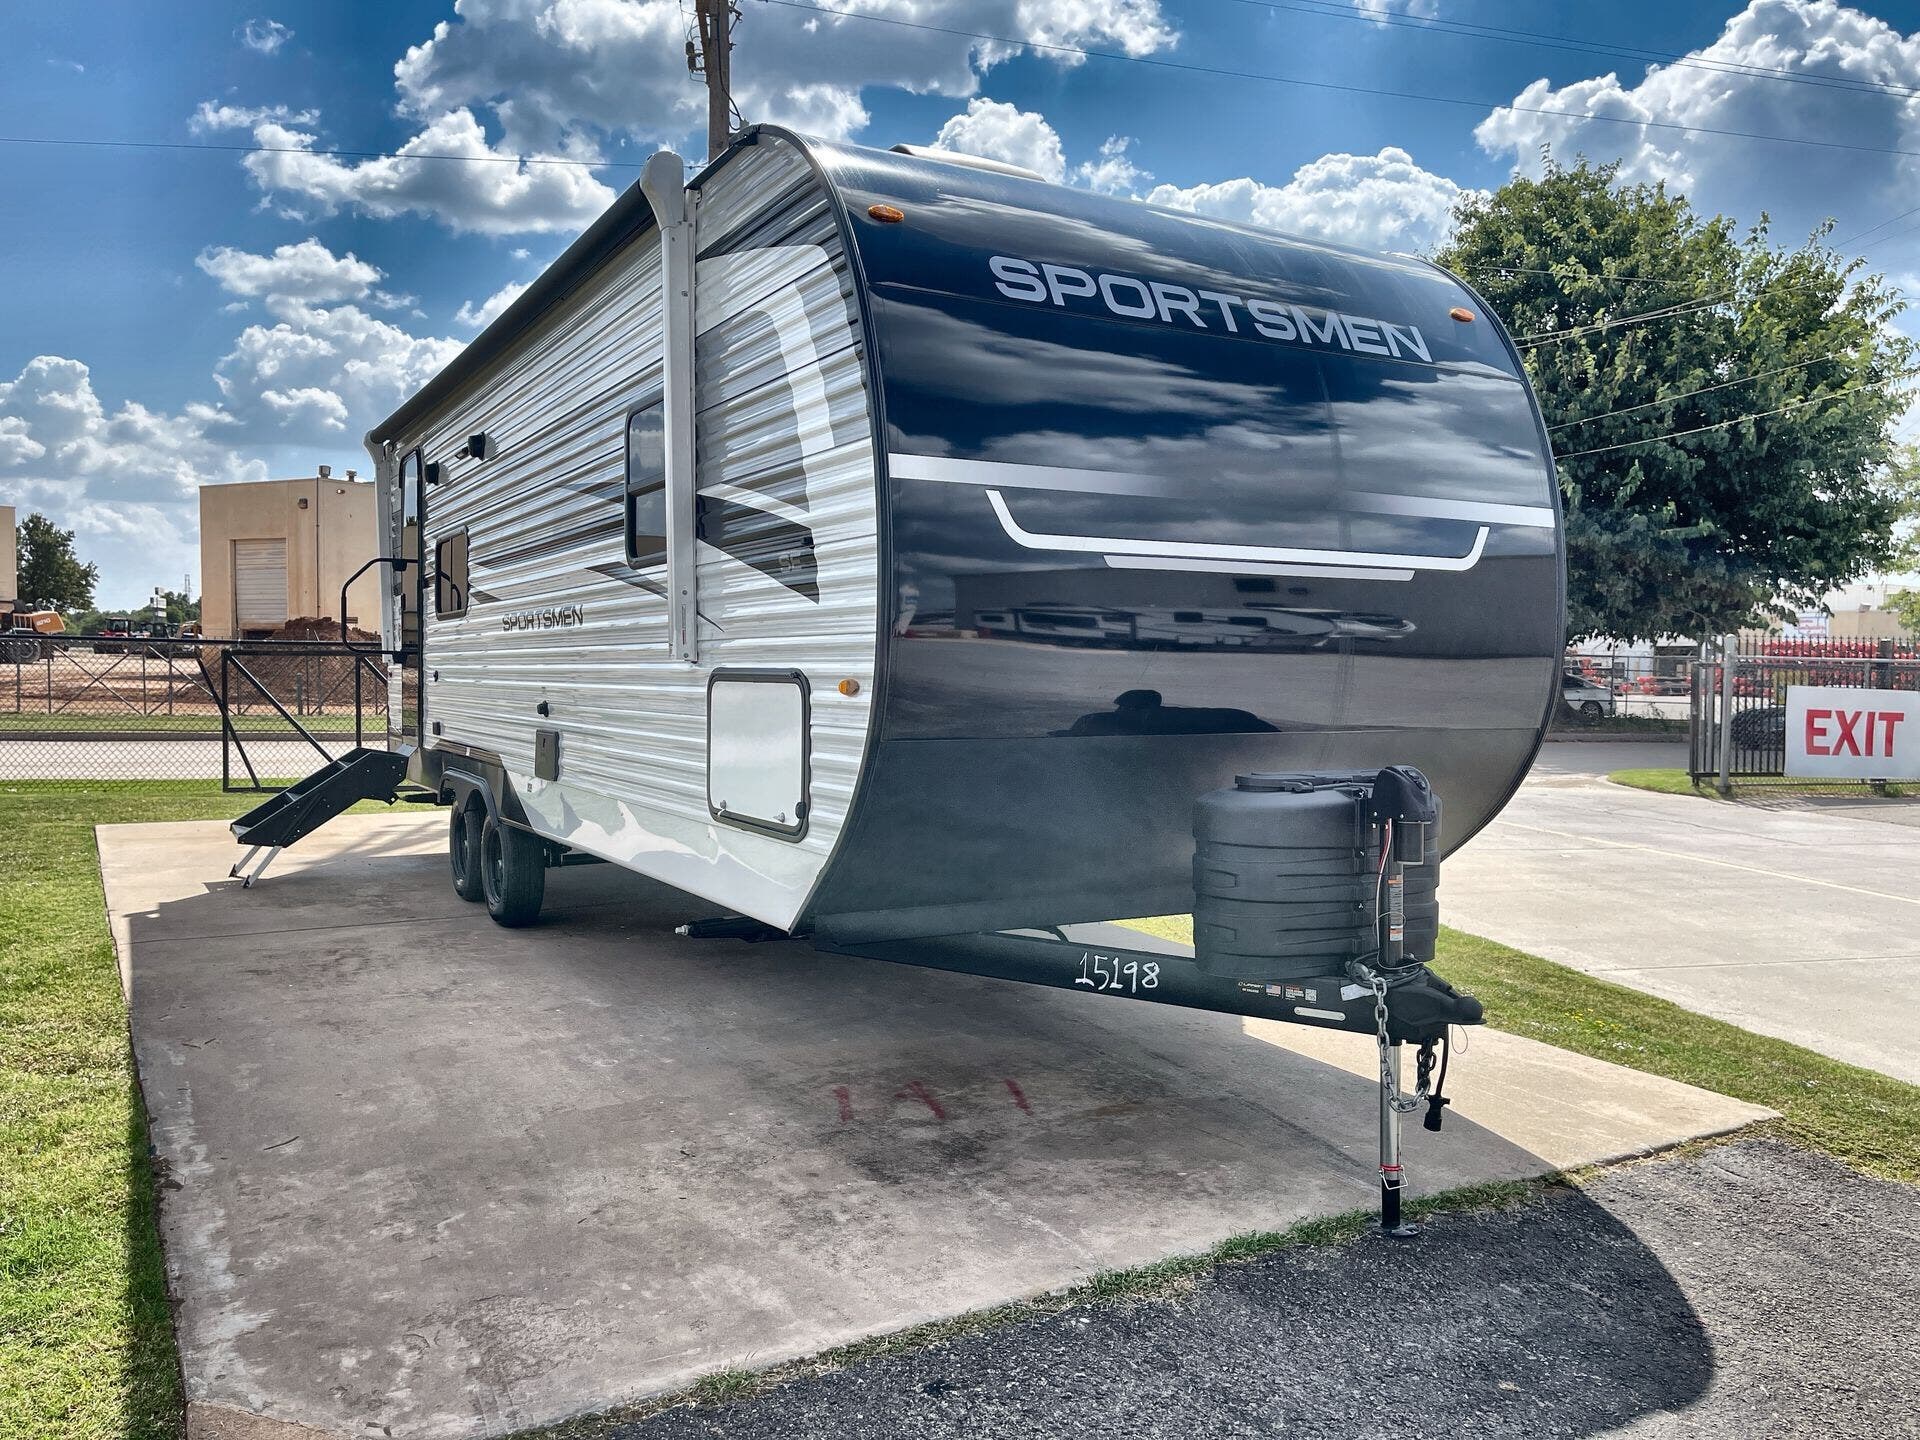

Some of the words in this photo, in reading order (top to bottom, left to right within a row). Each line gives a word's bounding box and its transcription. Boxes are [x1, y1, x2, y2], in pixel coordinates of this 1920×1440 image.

[988, 256, 1433, 362] SPORTSMEN
[502, 605, 584, 631] SPORTSMEN
[1806, 709, 1904, 757] EXIT
[1075, 952, 1160, 993] 15198
